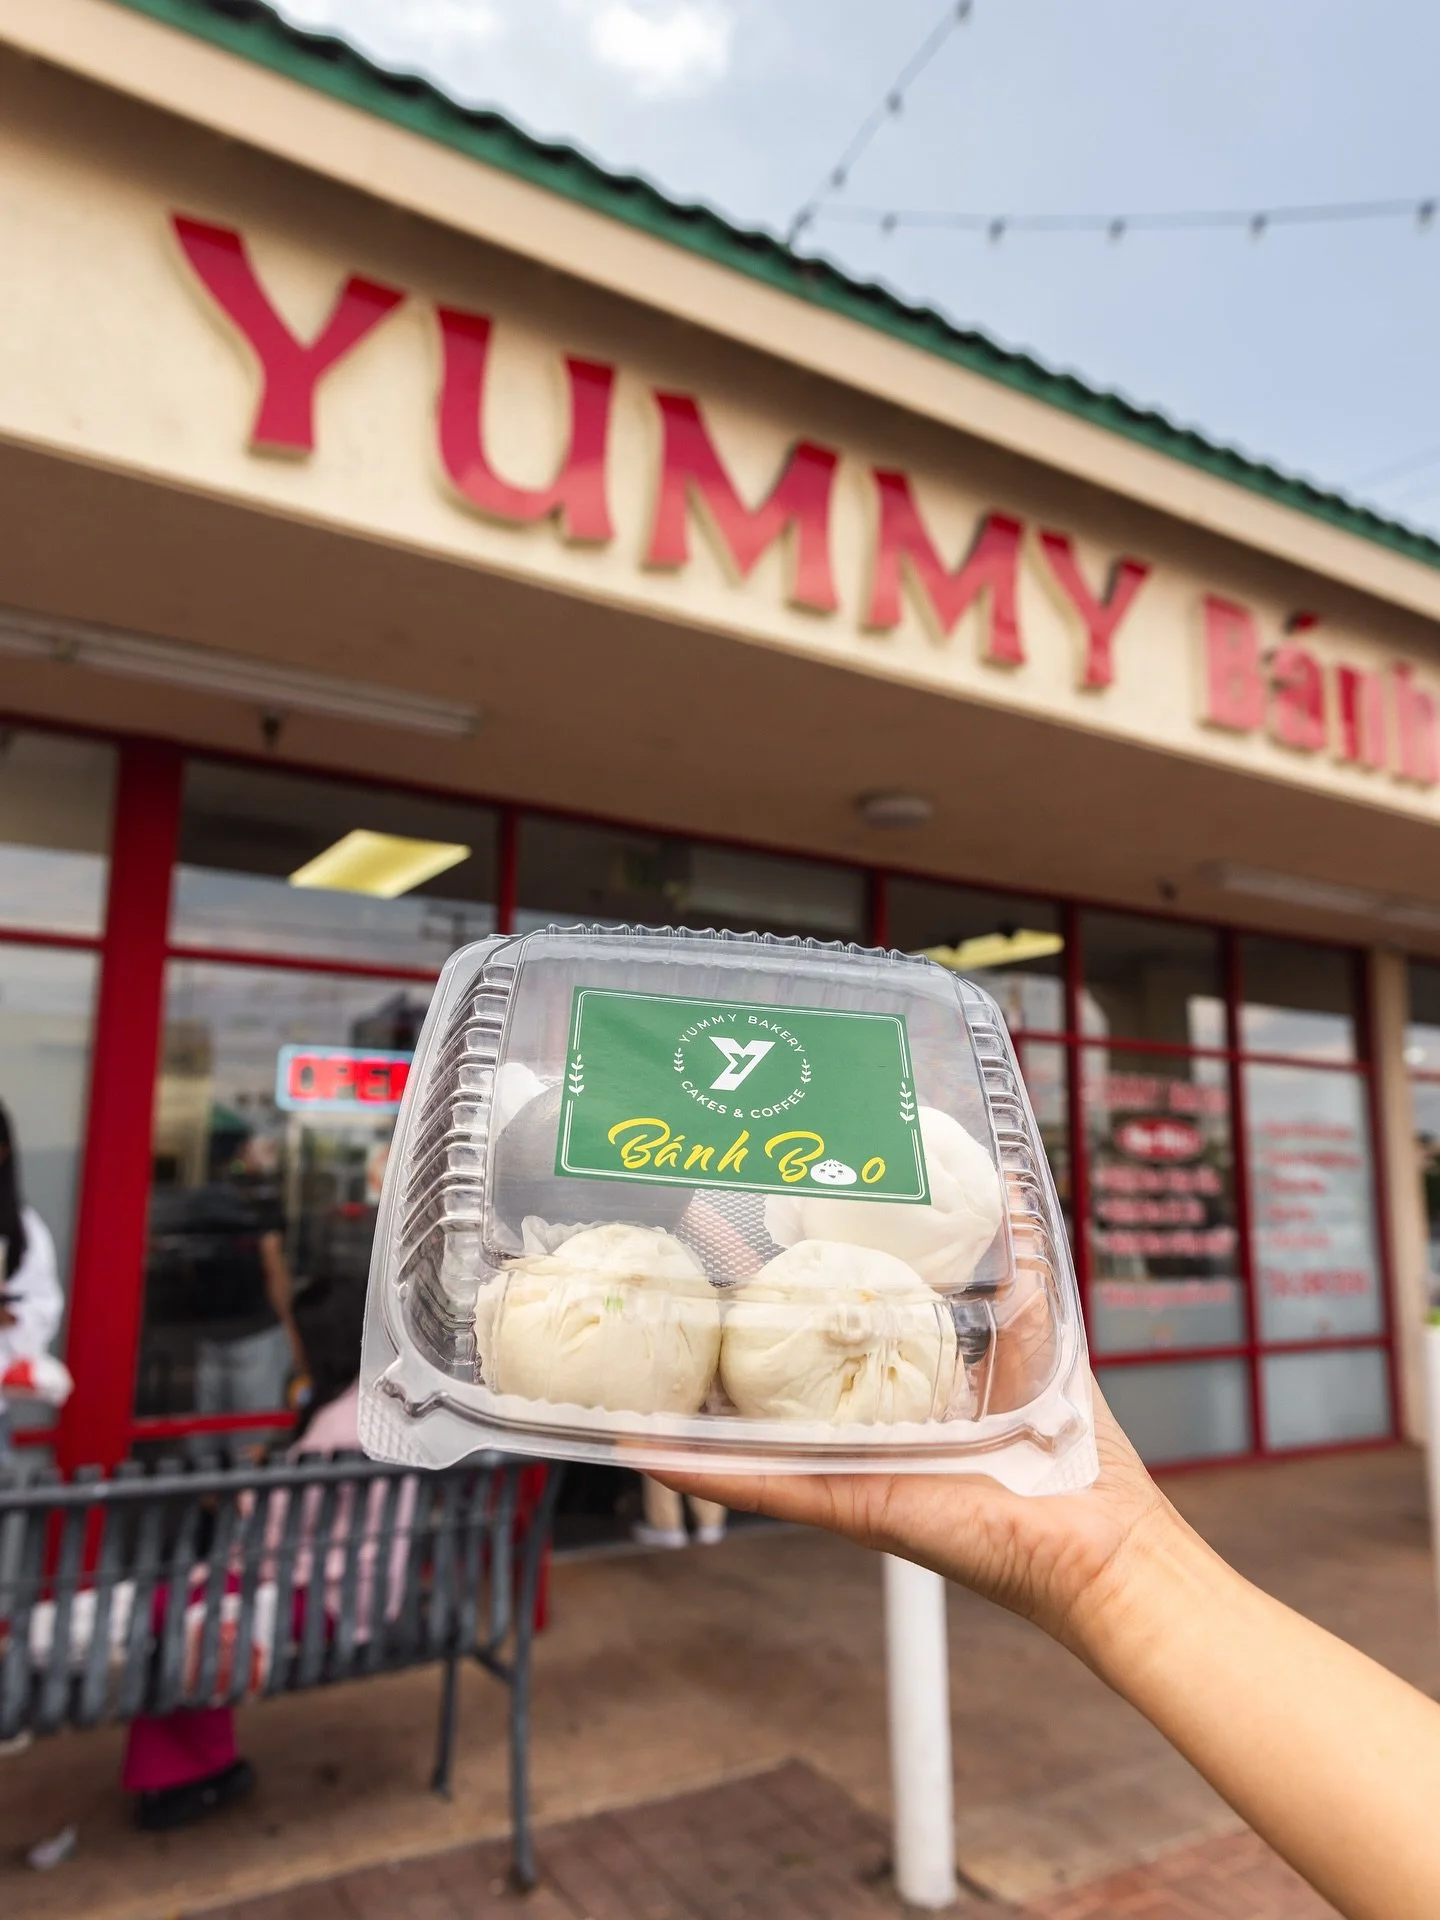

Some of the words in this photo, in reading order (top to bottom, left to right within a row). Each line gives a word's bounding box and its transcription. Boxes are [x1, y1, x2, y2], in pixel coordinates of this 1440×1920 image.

[170, 212, 1153, 691] YUMMY
[678, 1013, 737, 1044] YUMMY
[747, 1015, 806, 1054] BAKERY
[681, 1080, 727, 1115] CAKES
[733, 1108, 744, 1118] &
[750, 1088, 806, 1119] COFFEE
[607, 1117, 750, 1174] Bánh
